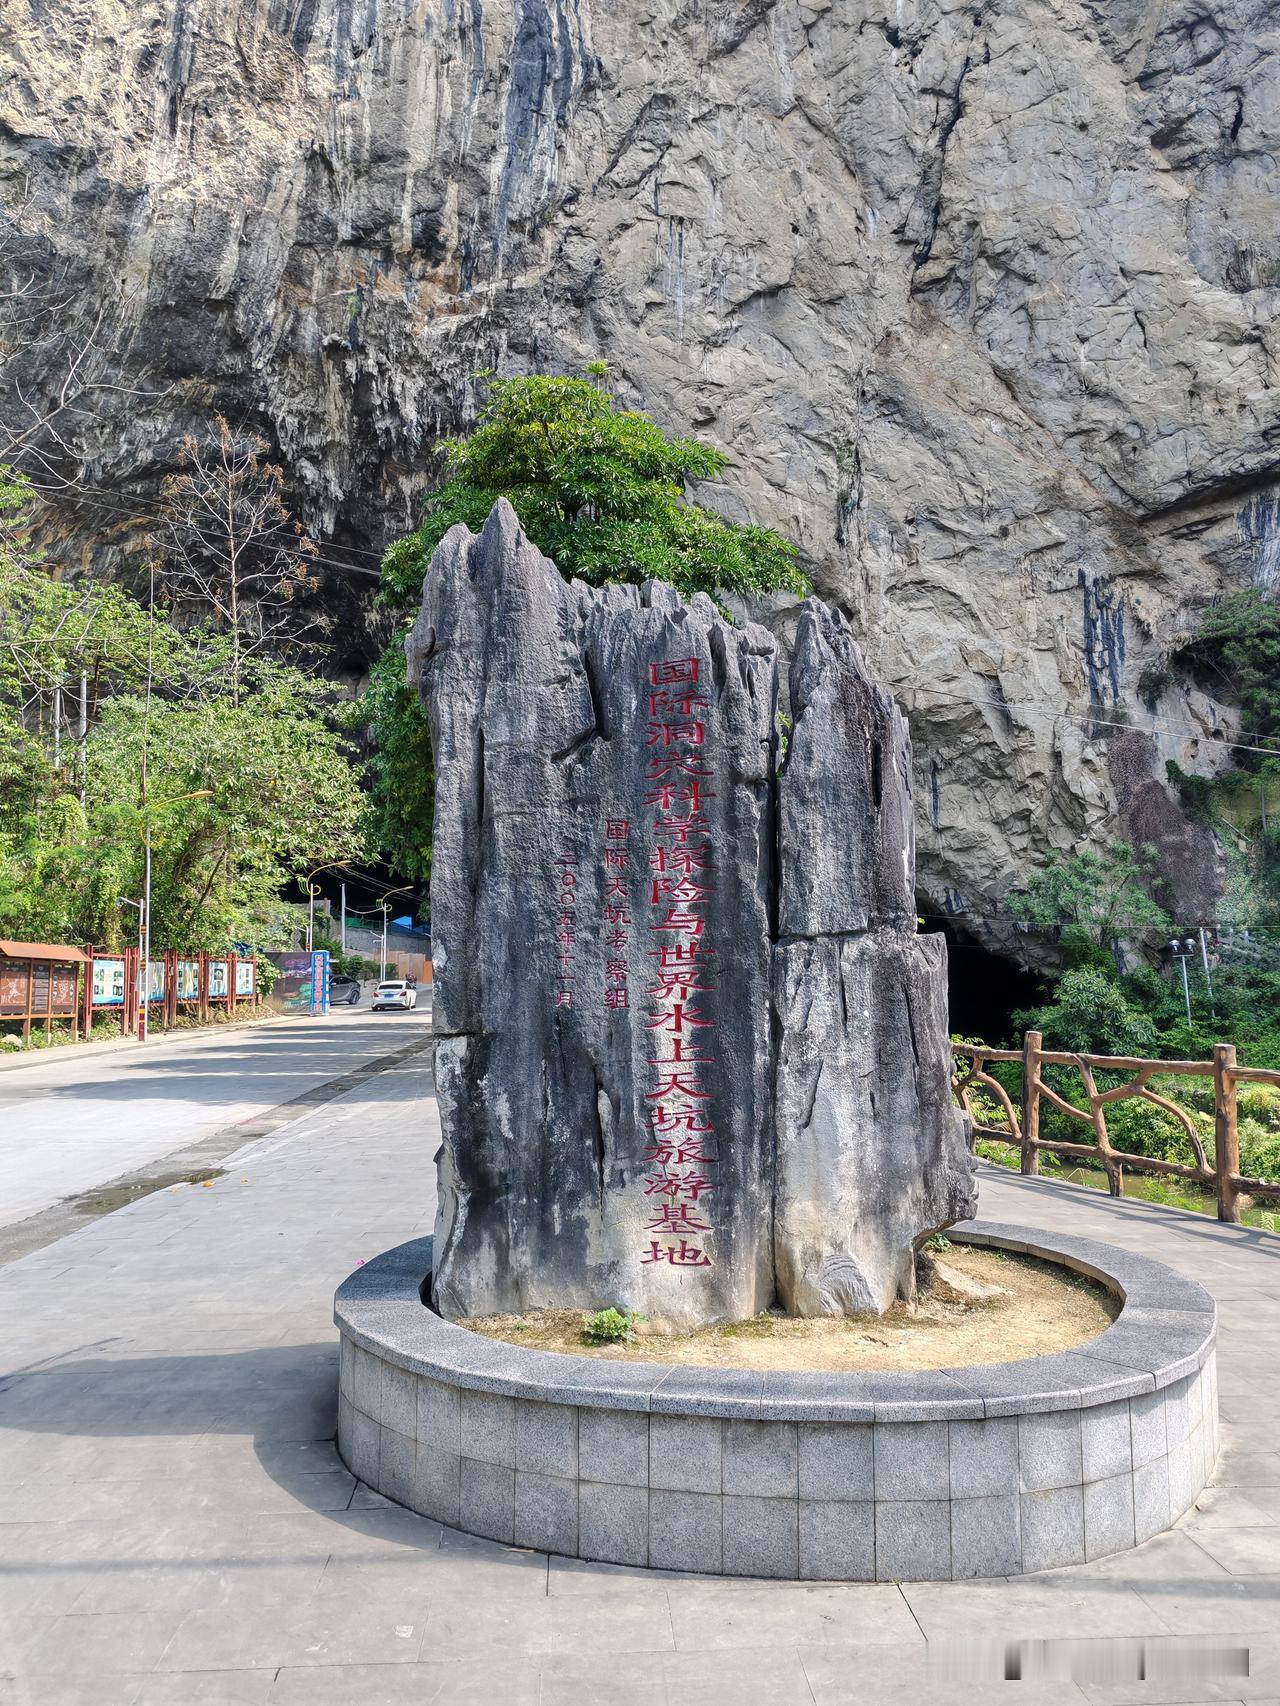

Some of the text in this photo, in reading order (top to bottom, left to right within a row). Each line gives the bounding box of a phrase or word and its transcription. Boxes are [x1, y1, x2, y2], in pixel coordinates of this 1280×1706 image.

[604, 819, 631, 1009] 国际天坑考察组
[642, 657, 717, 1267] 国际洞穴科学探险与世界水上天坑旅游基地
